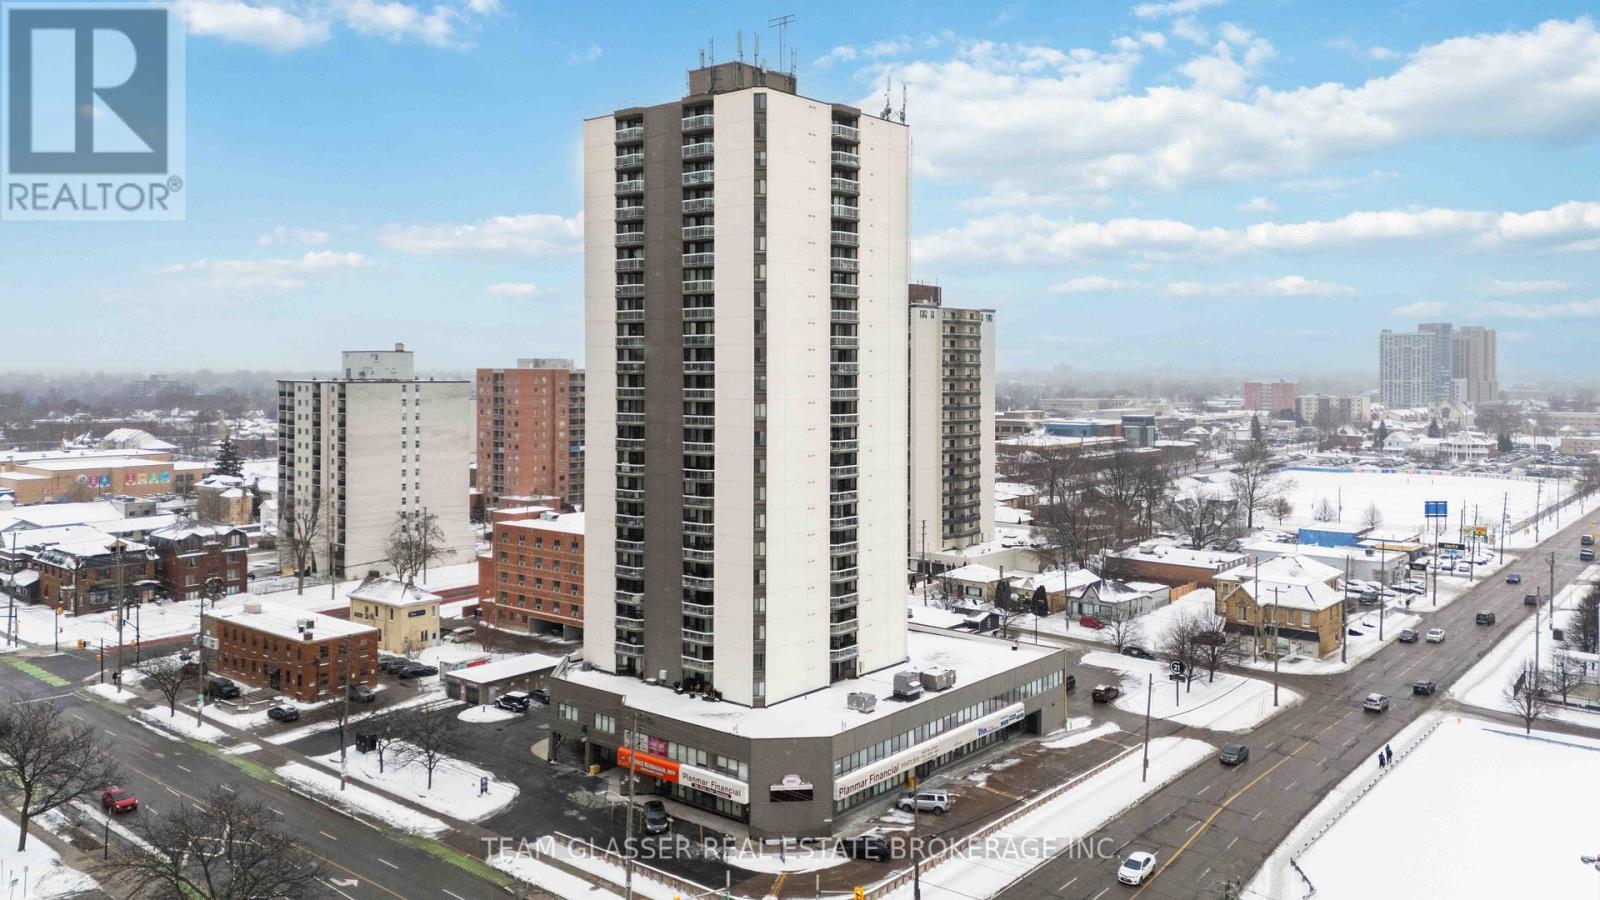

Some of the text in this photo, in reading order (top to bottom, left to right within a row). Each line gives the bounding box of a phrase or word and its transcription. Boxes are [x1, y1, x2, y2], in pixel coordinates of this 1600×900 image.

[682, 772, 709, 786] Planmar
[711, 781, 742, 797] Financial
[839, 763, 900, 798] Planmar Financial
